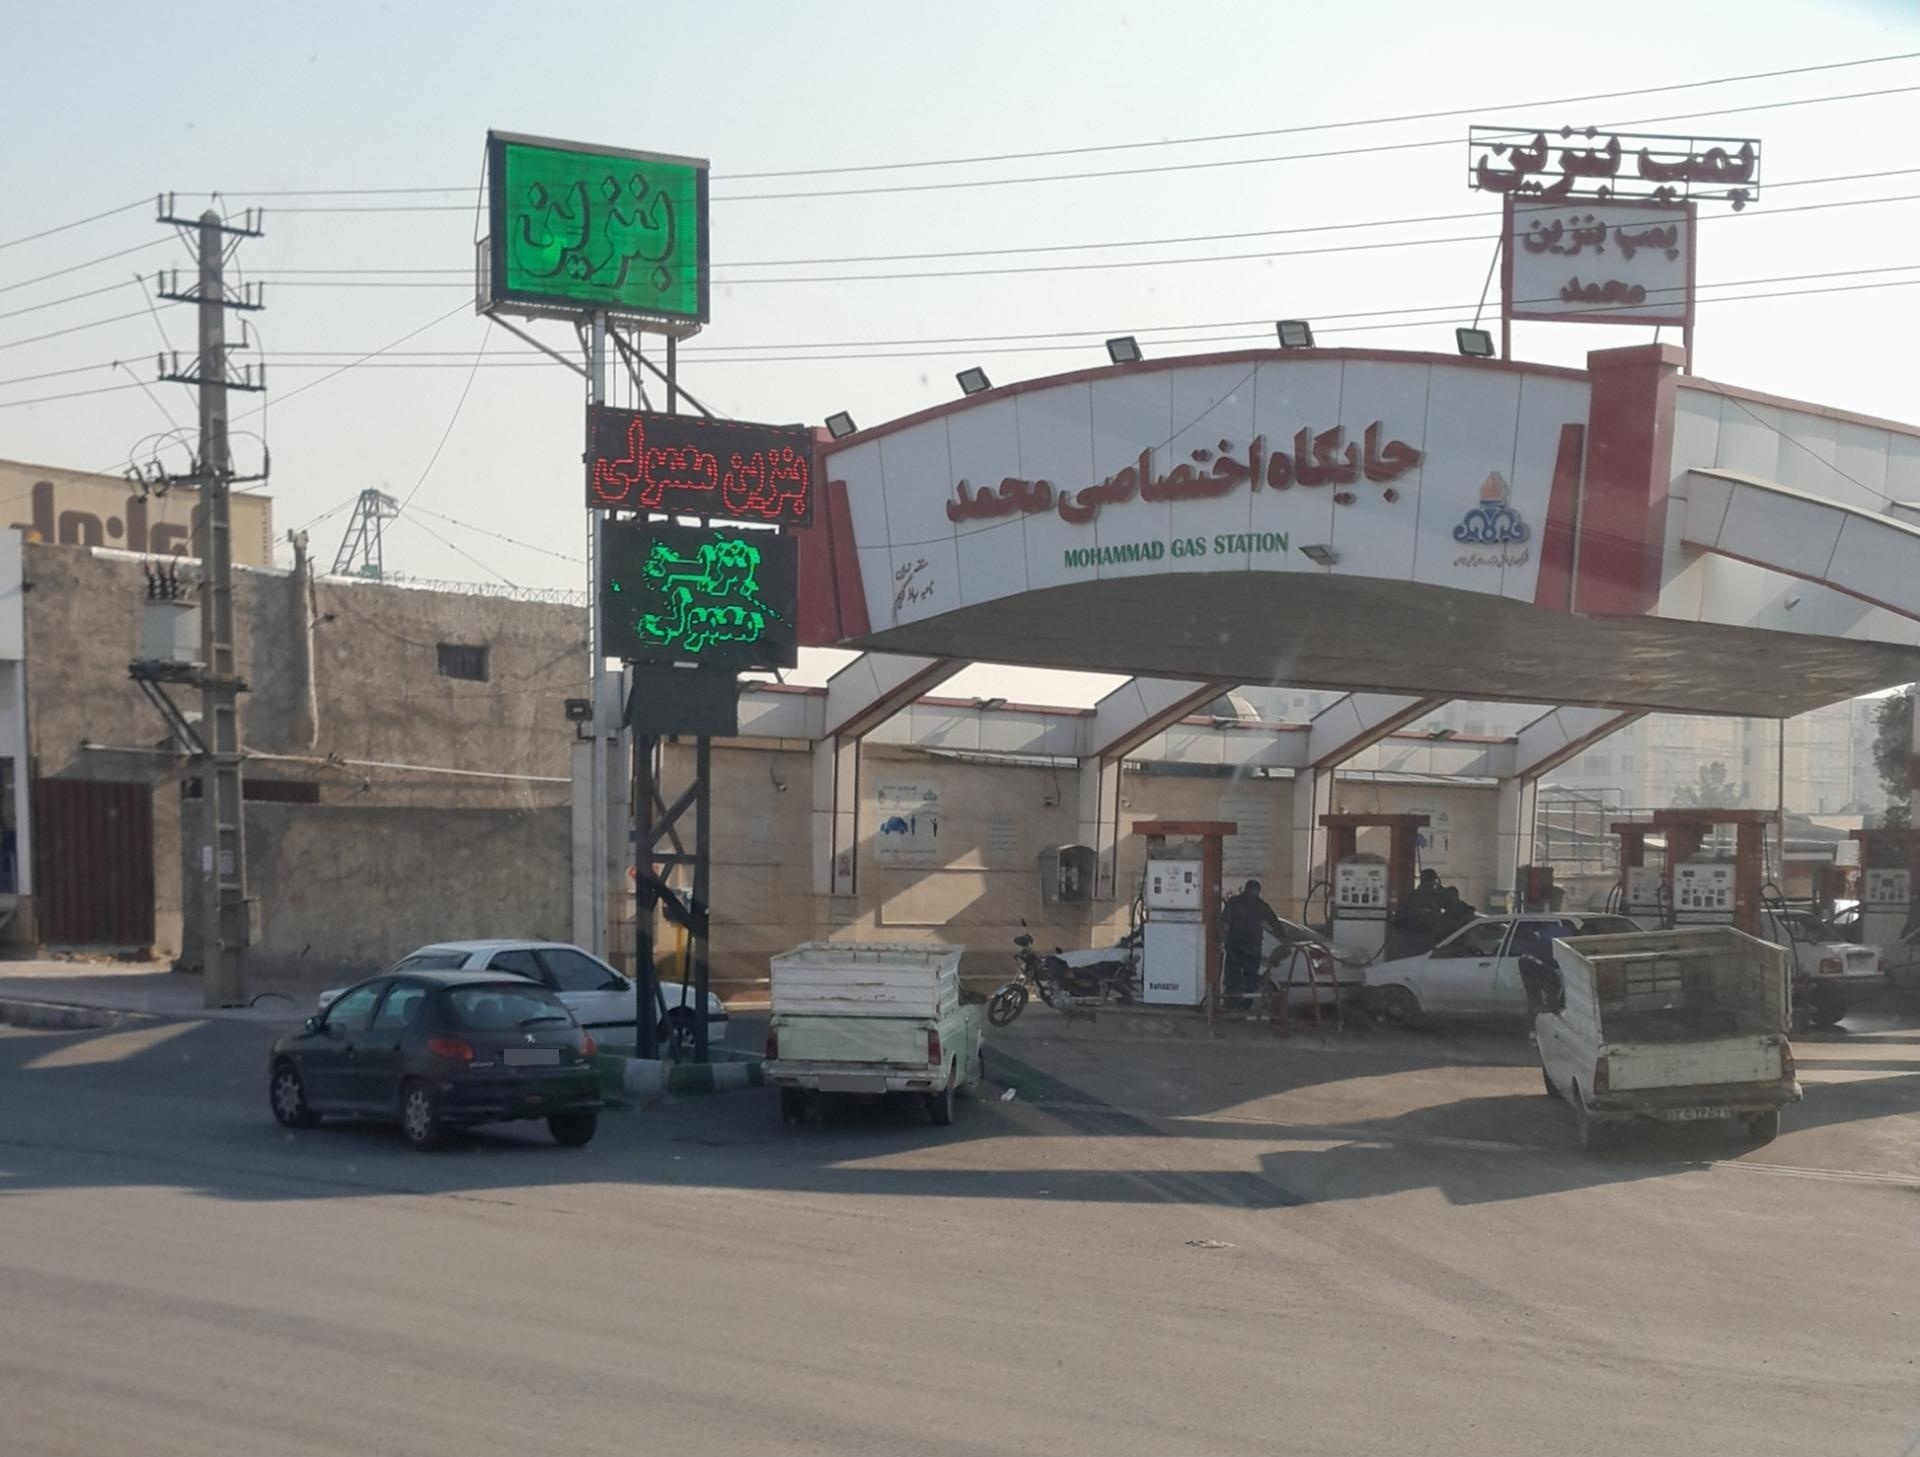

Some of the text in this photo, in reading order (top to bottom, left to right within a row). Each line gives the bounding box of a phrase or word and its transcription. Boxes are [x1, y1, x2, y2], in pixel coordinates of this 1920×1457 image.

[1476, 125, 1755, 212] پمپ بنزین
[513, 173, 676, 292] بنزین
[1523, 213, 1680, 261] پمپ بنزین
[1559, 275, 1648, 304] محمد
[722, 446, 809, 518] بنزین
[945, 420, 1425, 524] جایگاه اختصاصی محمد
[1064, 531, 1290, 569] MOHAMMAD GAS STATION
